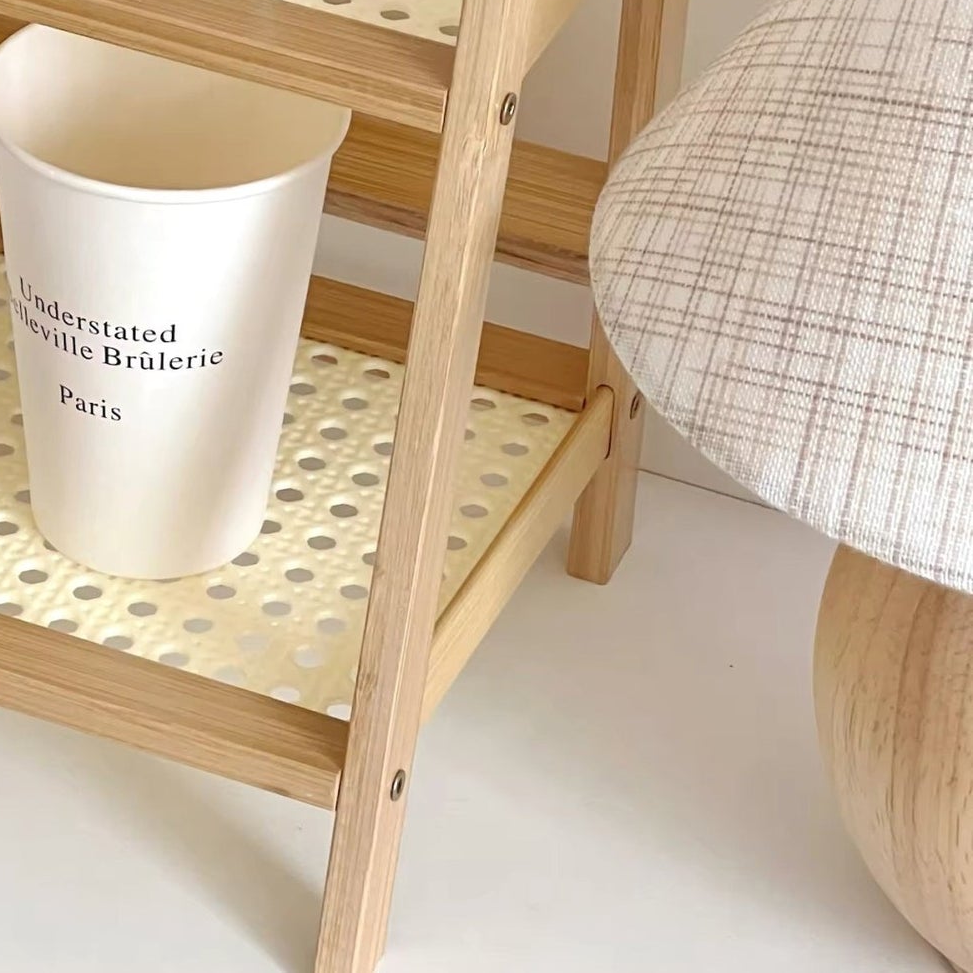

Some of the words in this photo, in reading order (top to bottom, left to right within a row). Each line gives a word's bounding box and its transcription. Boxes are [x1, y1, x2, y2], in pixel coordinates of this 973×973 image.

[10, 297, 94, 360] elleville
[102, 344, 225, 371] Brûlerie
[19, 275, 177, 343] Understated
[59, 384, 122, 422] Paris
